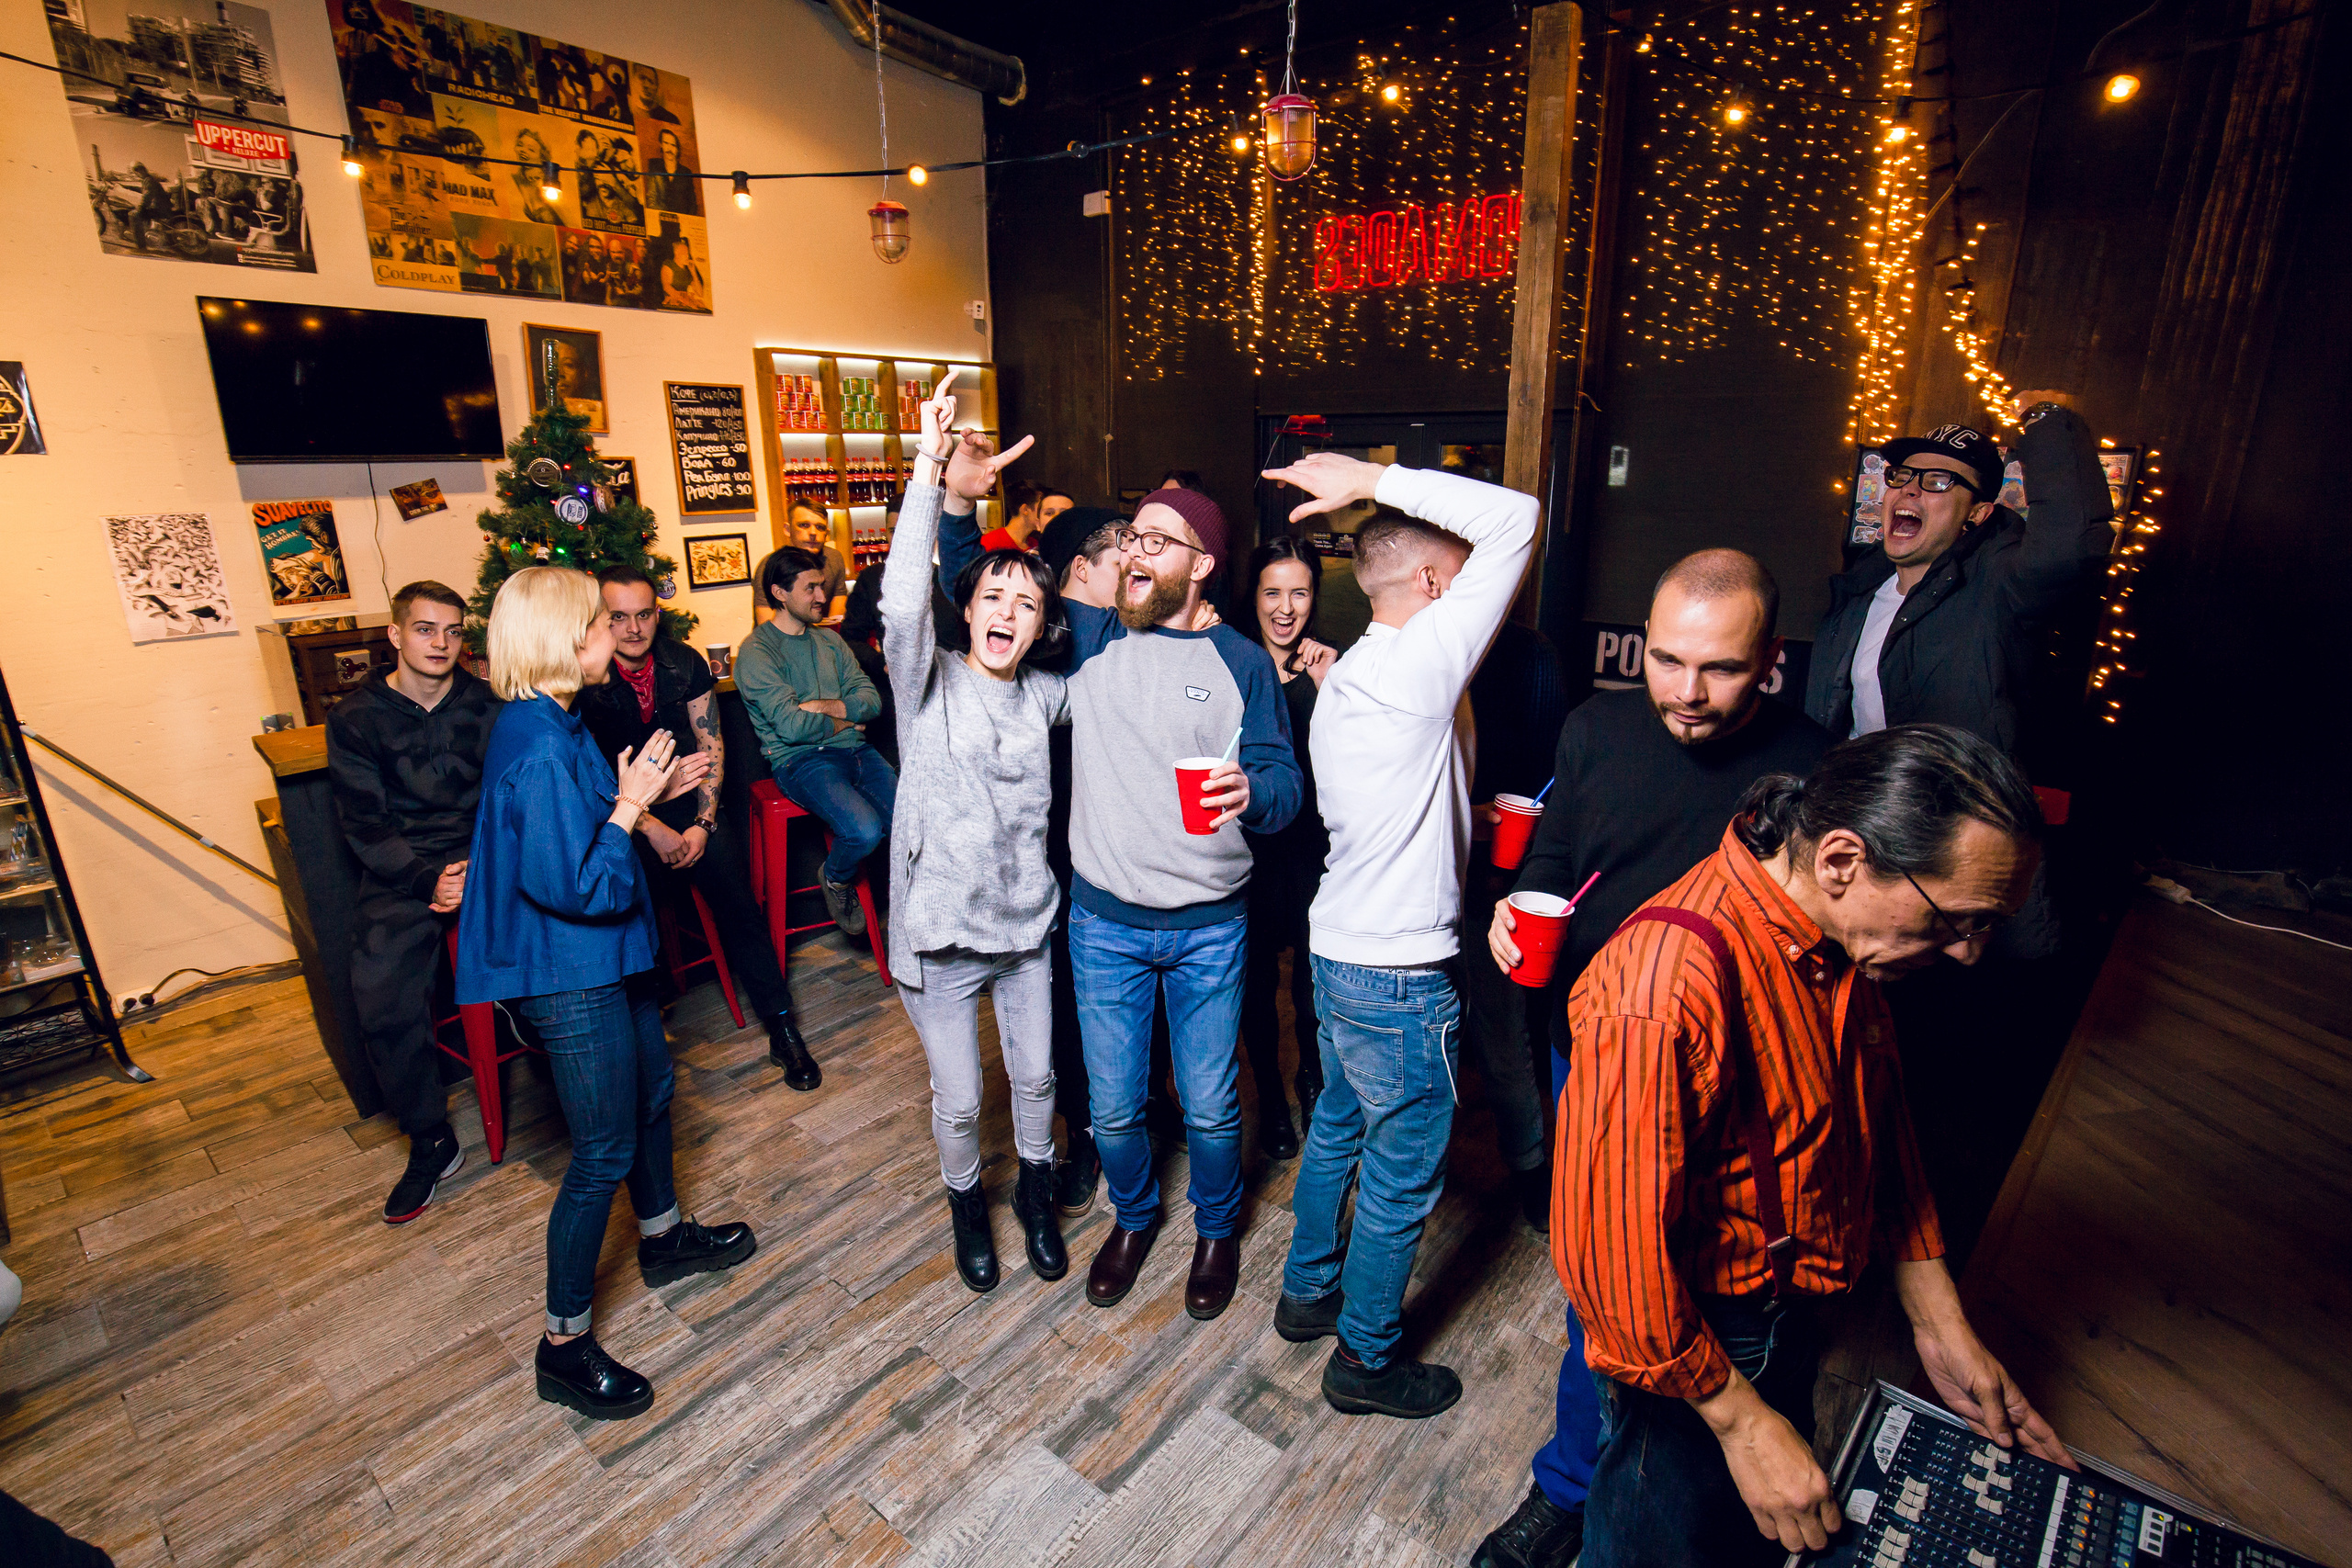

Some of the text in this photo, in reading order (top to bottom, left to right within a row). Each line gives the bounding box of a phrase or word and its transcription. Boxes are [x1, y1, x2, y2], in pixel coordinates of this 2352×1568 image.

[447, 83, 515, 106] RADIOHEAD
[197, 122, 287, 157] UPPERCUT
[232, 147, 260, 157] DELUXE
[469, 186, 498, 207] MAX
[388, 207, 405, 220] The
[252, 501, 332, 528] SUAVECITO
[260, 532, 277, 544] GET
[265, 530, 300, 550] HOMBRE!
